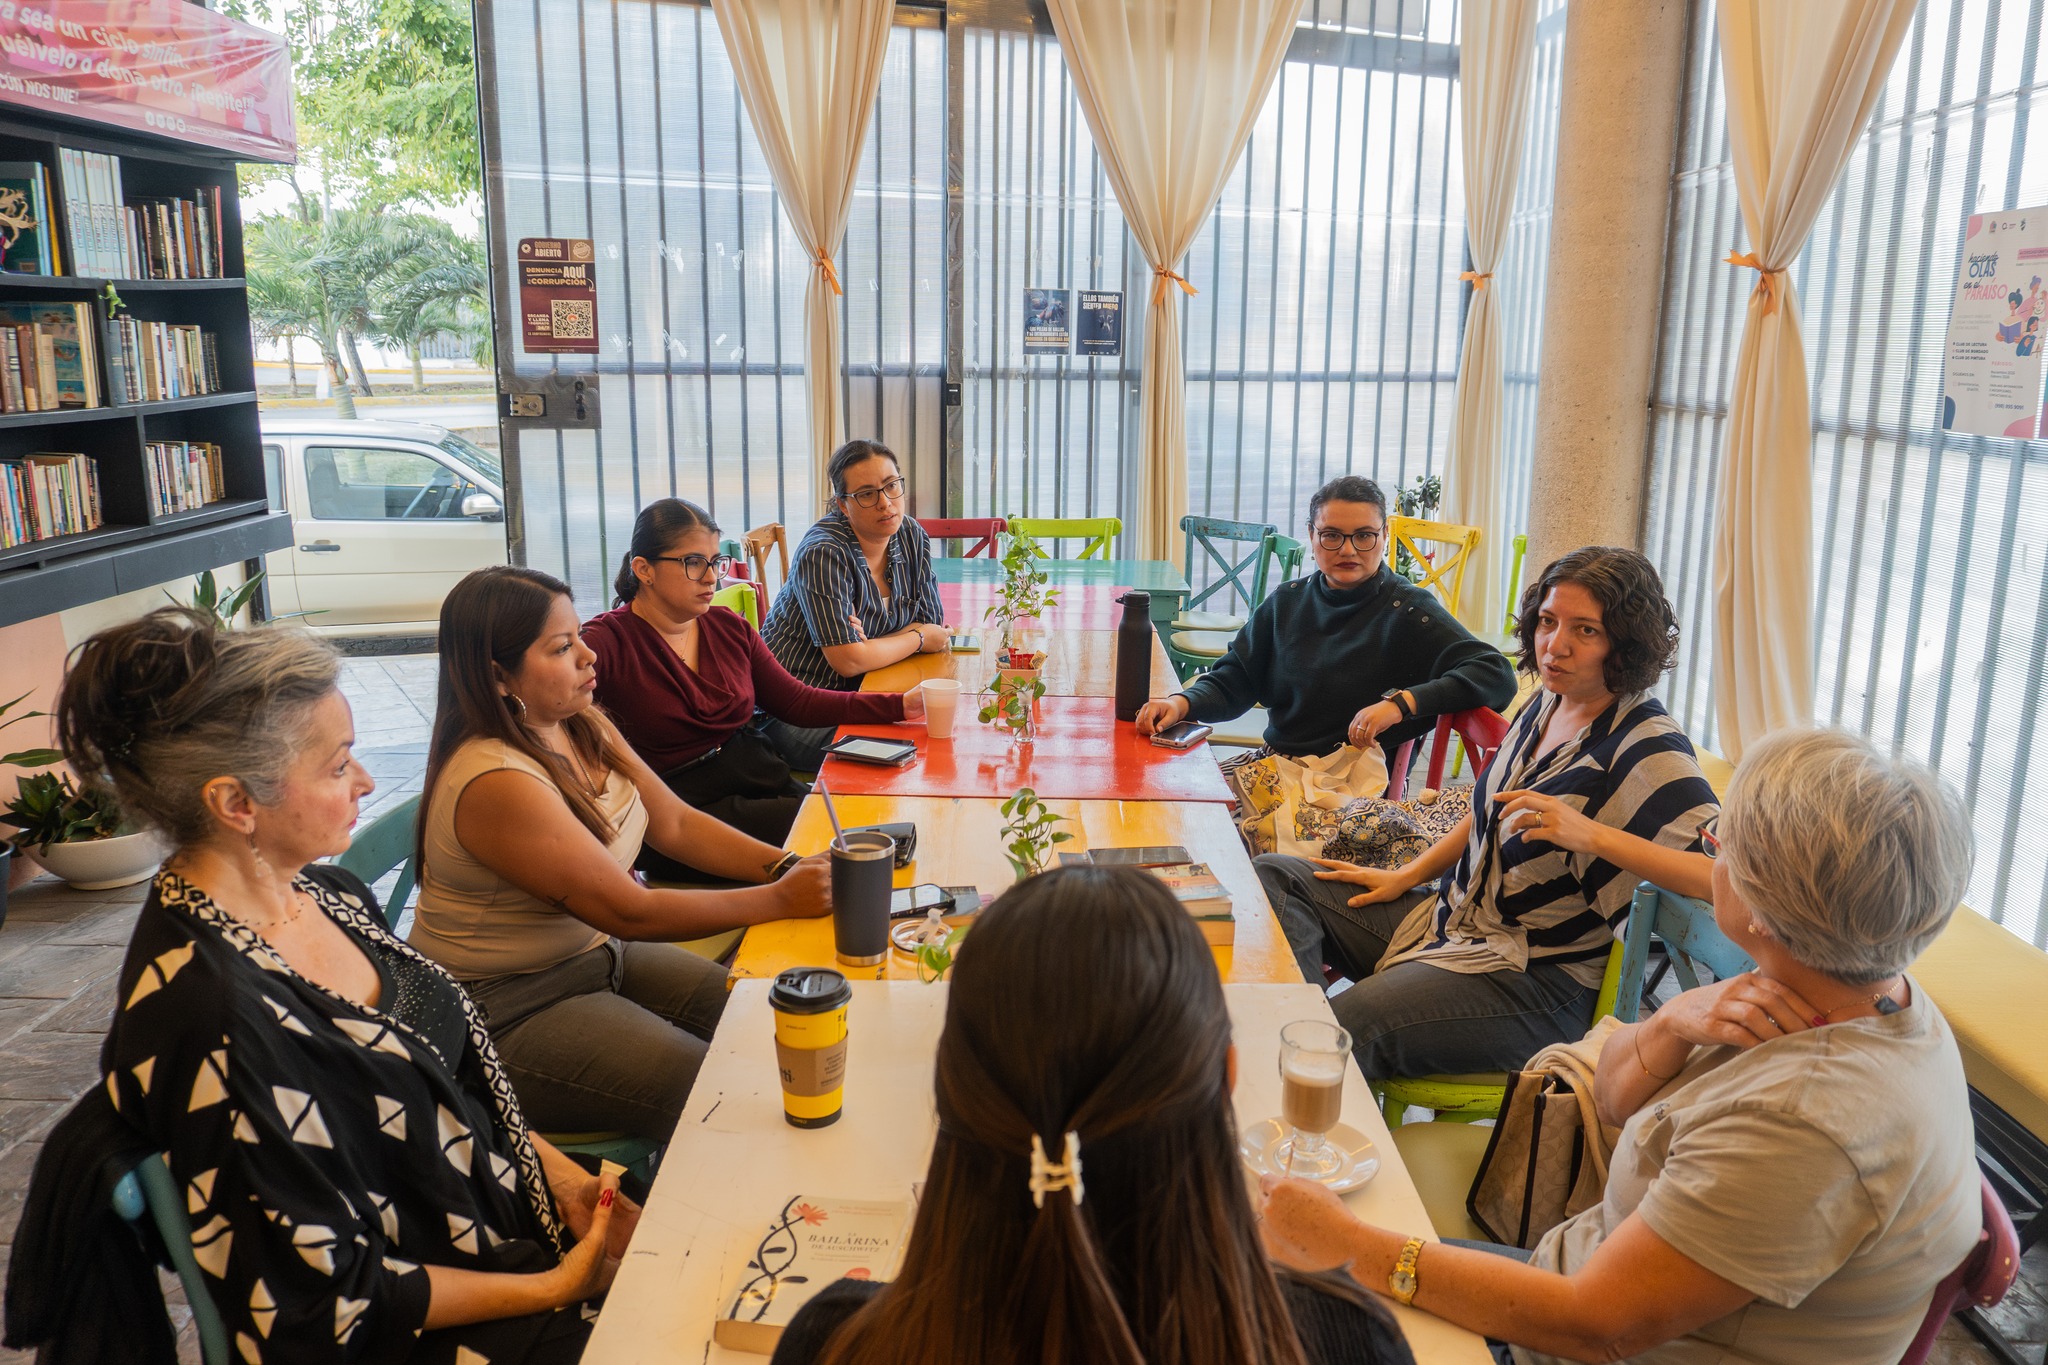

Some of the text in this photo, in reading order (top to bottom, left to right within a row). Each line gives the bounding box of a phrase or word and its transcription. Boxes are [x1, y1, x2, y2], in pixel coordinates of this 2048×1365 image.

[19, 6, 55, 33] sea
[59, 19, 89, 41] un
[91, 26, 139, 54] ciclo
[80, 57, 92, 74] o
[96, 57, 147, 87] dona
[150, 74, 187, 97] otro.
[24, 79, 51, 99] NOS
[52, 85, 79, 105] UNE!
[534, 248, 562, 258] ABIERTO
[1968, 251, 1999, 263] haciendo
[526, 264, 586, 279] DENUNCIA AQUÍ
[1969, 261, 1997, 278] OLAS
[531, 278, 587, 286] CORRUPCIÓN
[1964, 277, 2008, 300] PARAÍSO
[1083, 293, 1119, 303] ELLOS TAMBIÉN
[808, 1234, 889, 1246] BAILARINA
[827, 1244, 880, 1252] AUSCHWITZ
